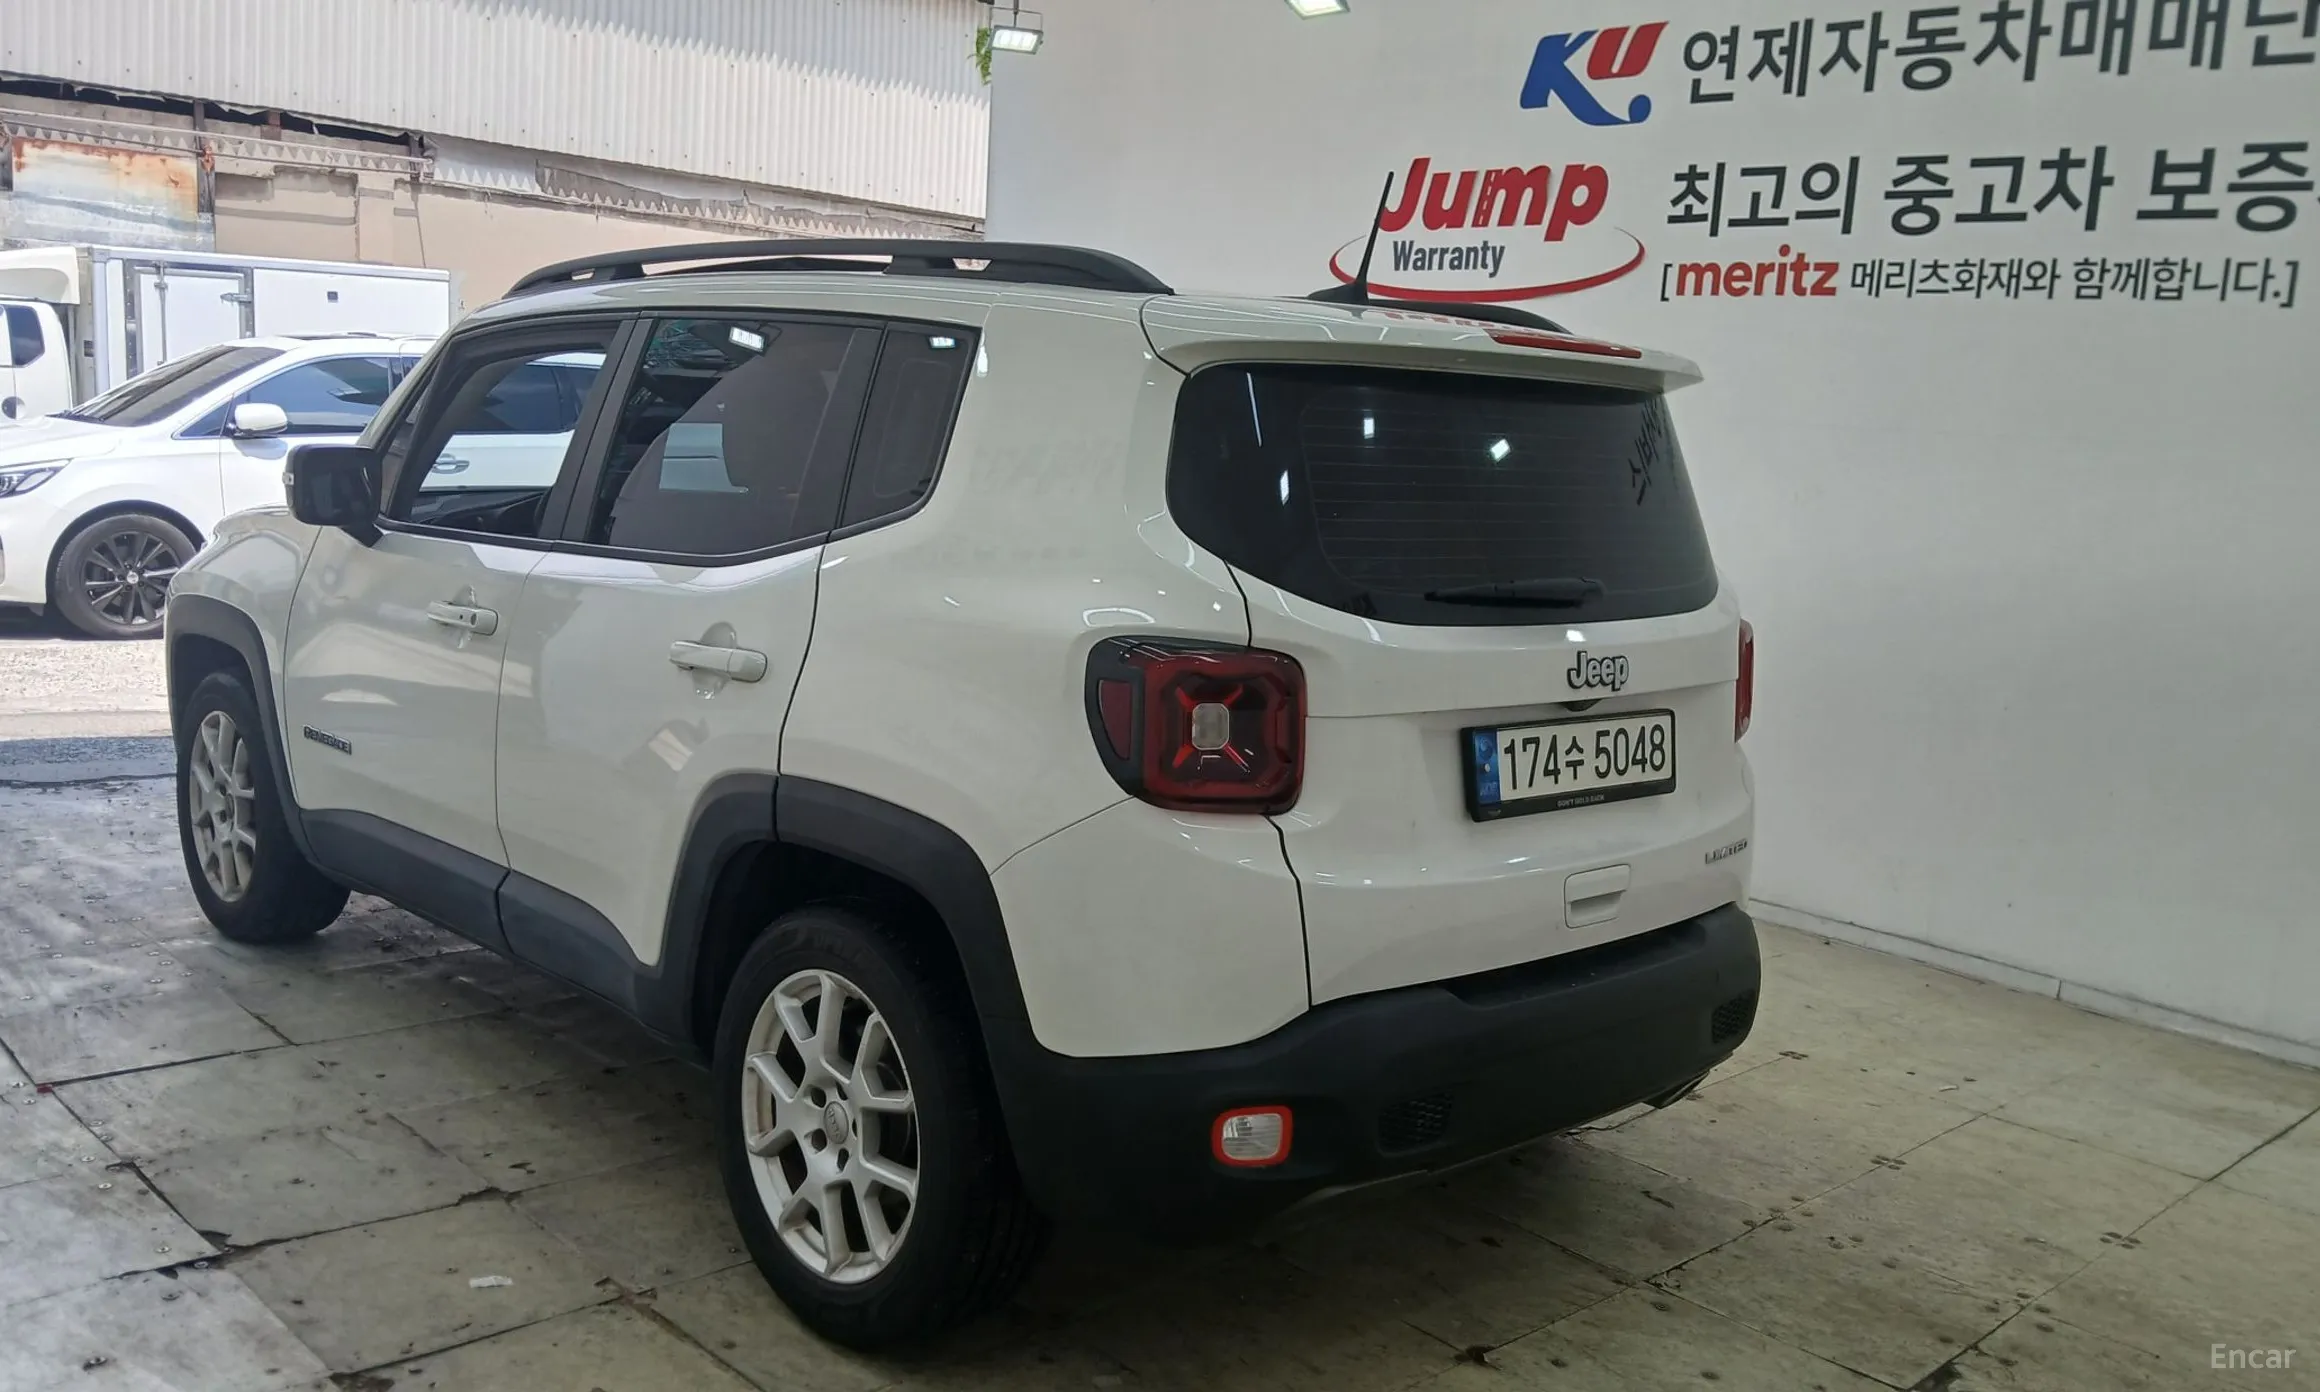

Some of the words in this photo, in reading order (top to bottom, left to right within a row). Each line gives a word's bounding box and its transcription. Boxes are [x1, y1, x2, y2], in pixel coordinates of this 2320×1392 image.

[1378, 156, 1609, 242] Jump
[1666, 155, 1861, 238] 최고의
[1883, 145, 2115, 236] 중고차
[2135, 141, 2320, 233] 보증
[1392, 239, 1506, 278] Warranty
[1850, 257, 2062, 299] 메리츠화재와
[1566, 650, 1630, 692] Jeep
